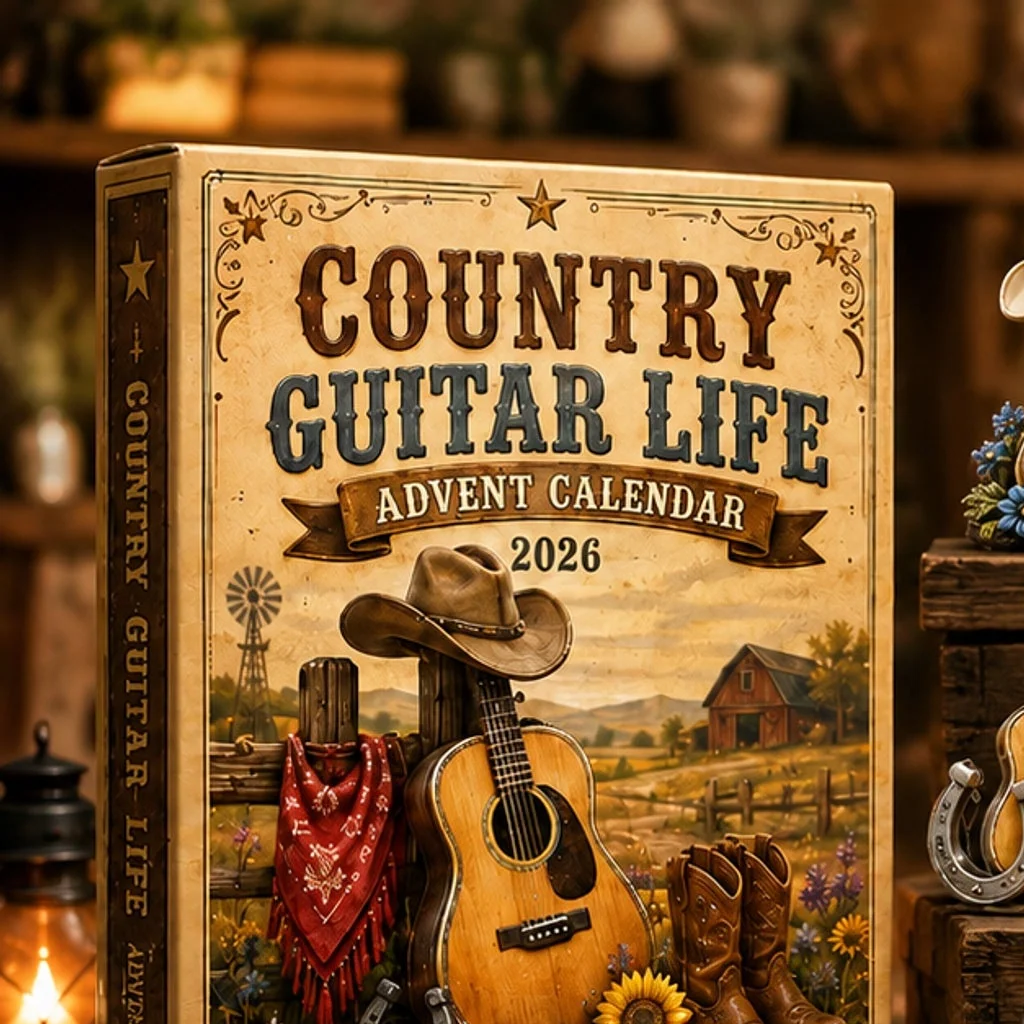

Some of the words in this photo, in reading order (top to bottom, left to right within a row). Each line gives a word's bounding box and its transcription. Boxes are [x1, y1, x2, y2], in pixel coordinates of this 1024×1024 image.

[295, 244, 791, 371] COUNTRY
[125, 380, 148, 590] COUNTRY
[265, 363, 612, 473] GUITAR
[642, 368, 829, 488] LIFE
[375, 474, 534, 525] ADVENT
[548, 474, 746, 531] CALENDAR
[510, 536, 601, 573] 2026
[125, 615, 148, 789] GUITAR
[125, 817, 148, 917] LIFE
